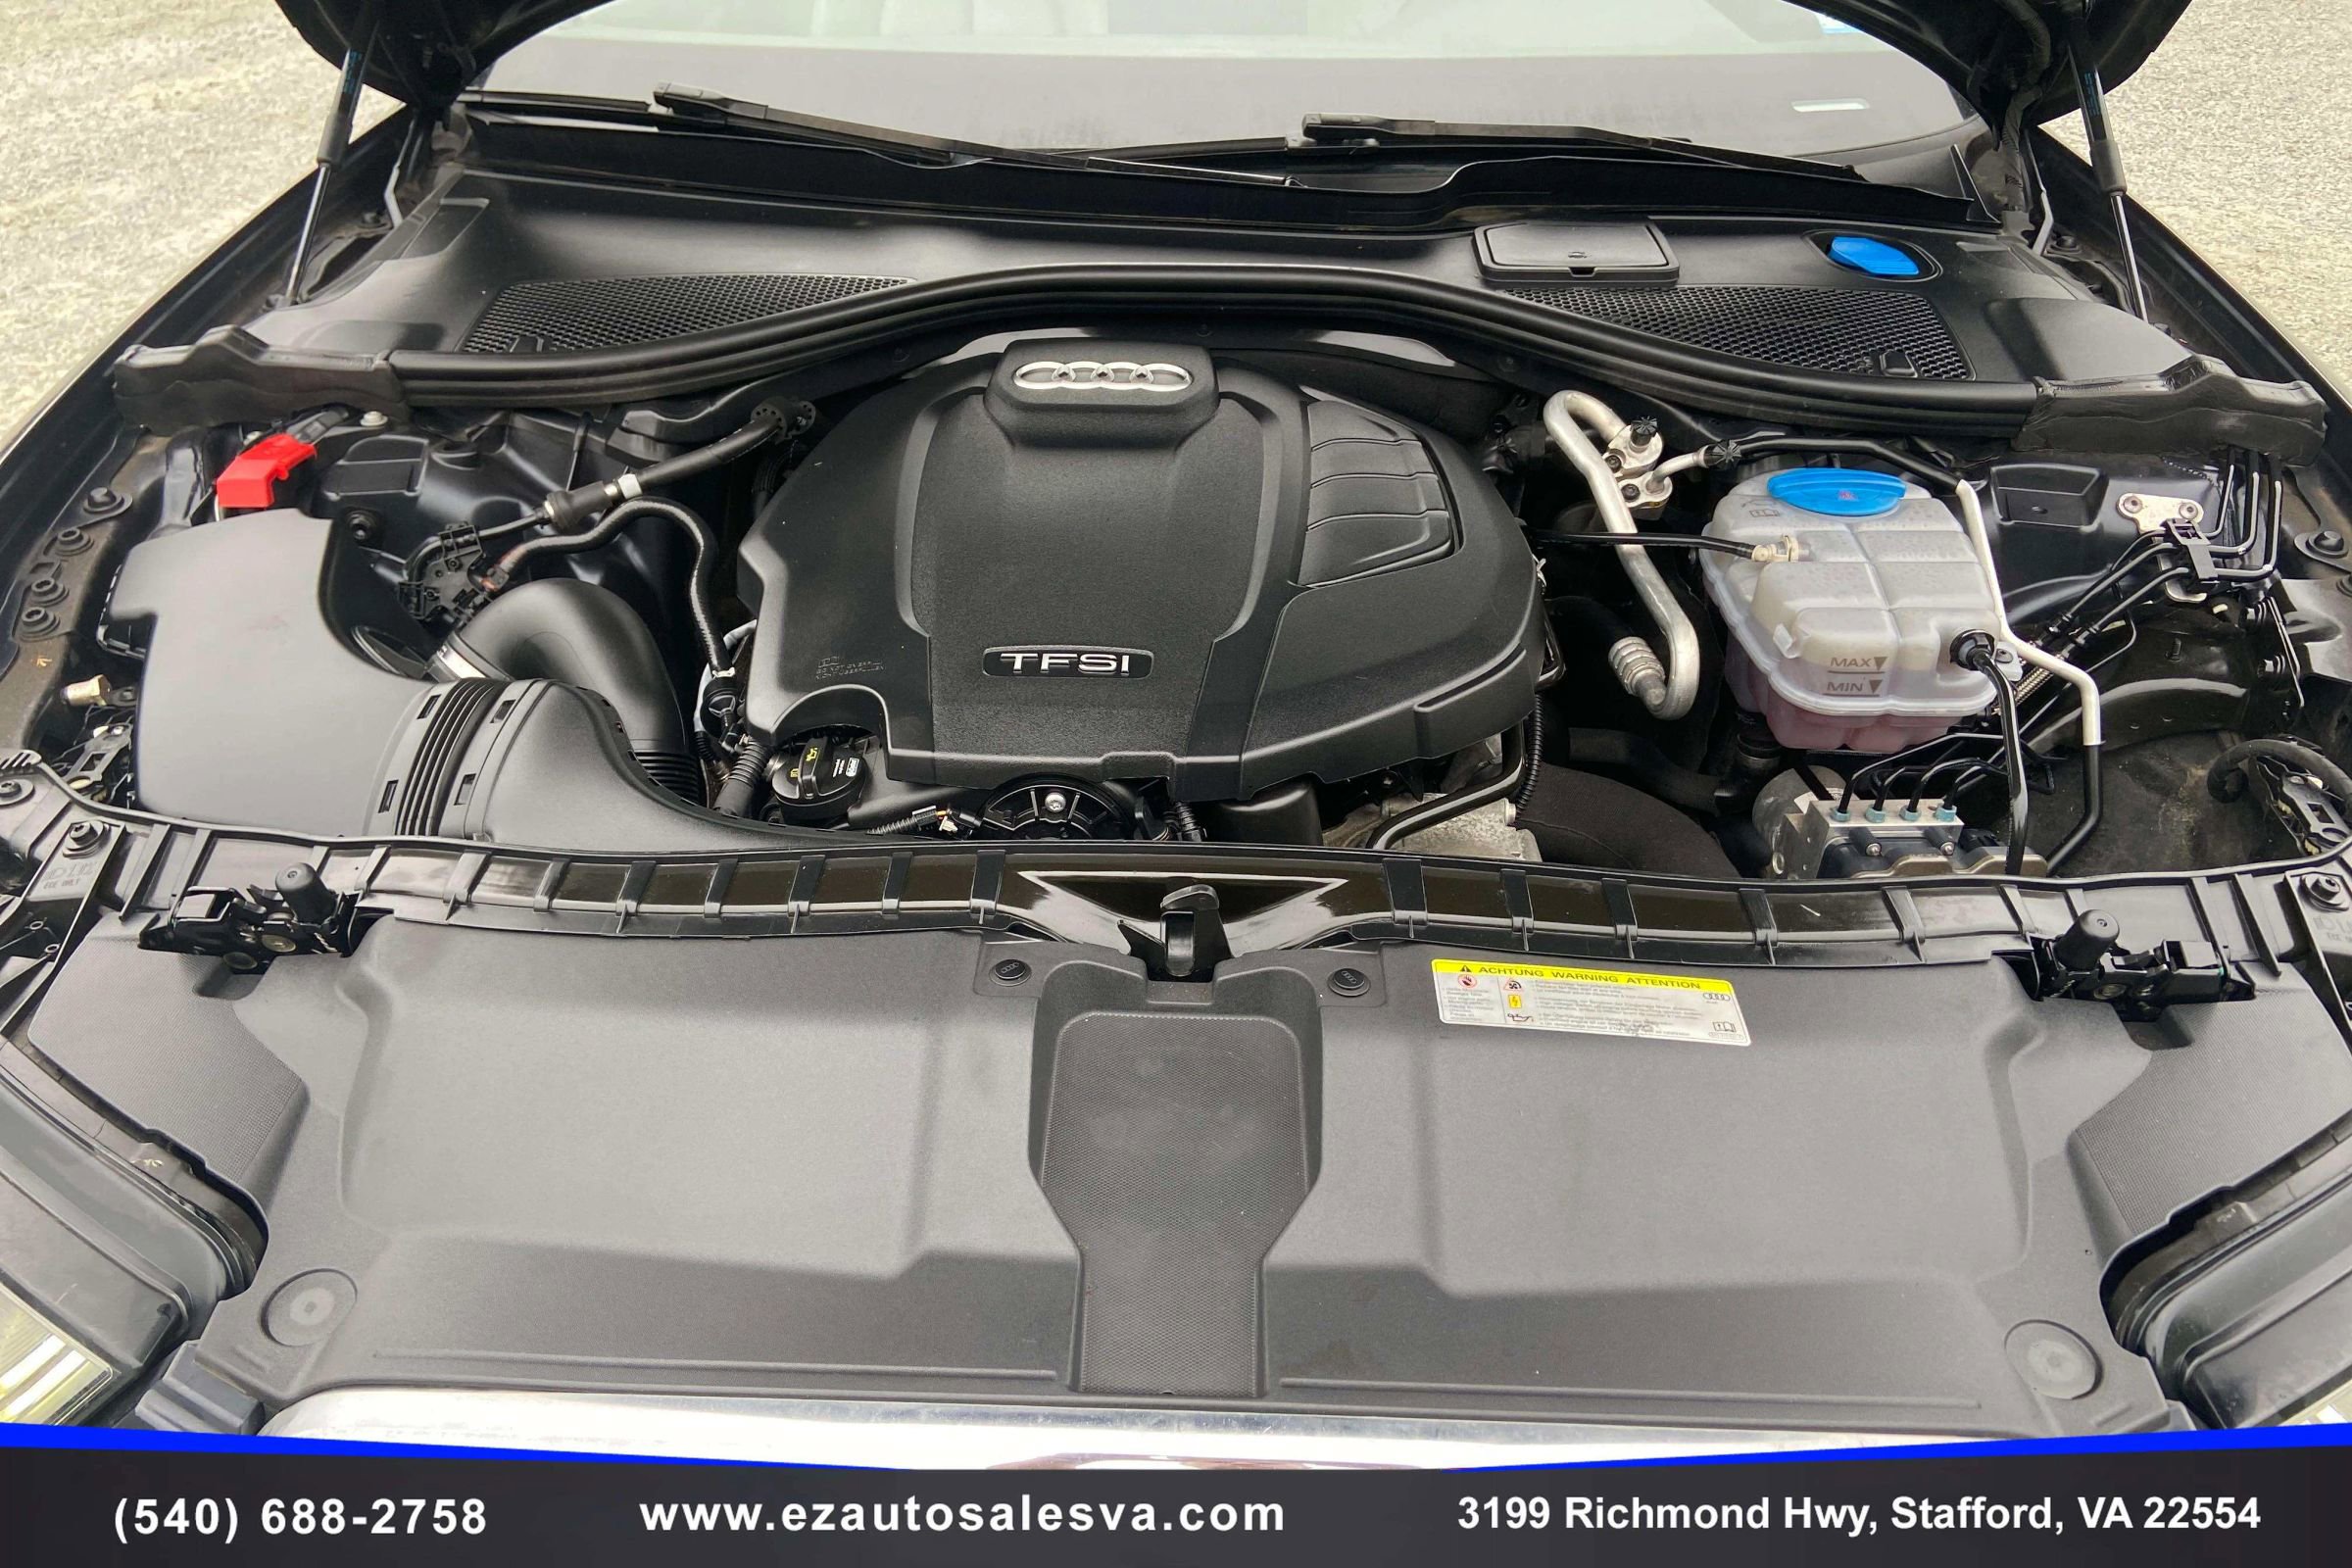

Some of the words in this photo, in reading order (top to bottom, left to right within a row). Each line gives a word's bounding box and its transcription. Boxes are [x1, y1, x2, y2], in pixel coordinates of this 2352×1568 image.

[1000, 652, 1131, 677] TFSI
[1830, 657, 1872, 667] MAX
[1826, 681, 1864, 692] MIN
[1478, 966, 1544, 977] ACHTUNG
[1550, 971, 1619, 983] WARNING
[1626, 977, 1701, 989] ATTENTION
